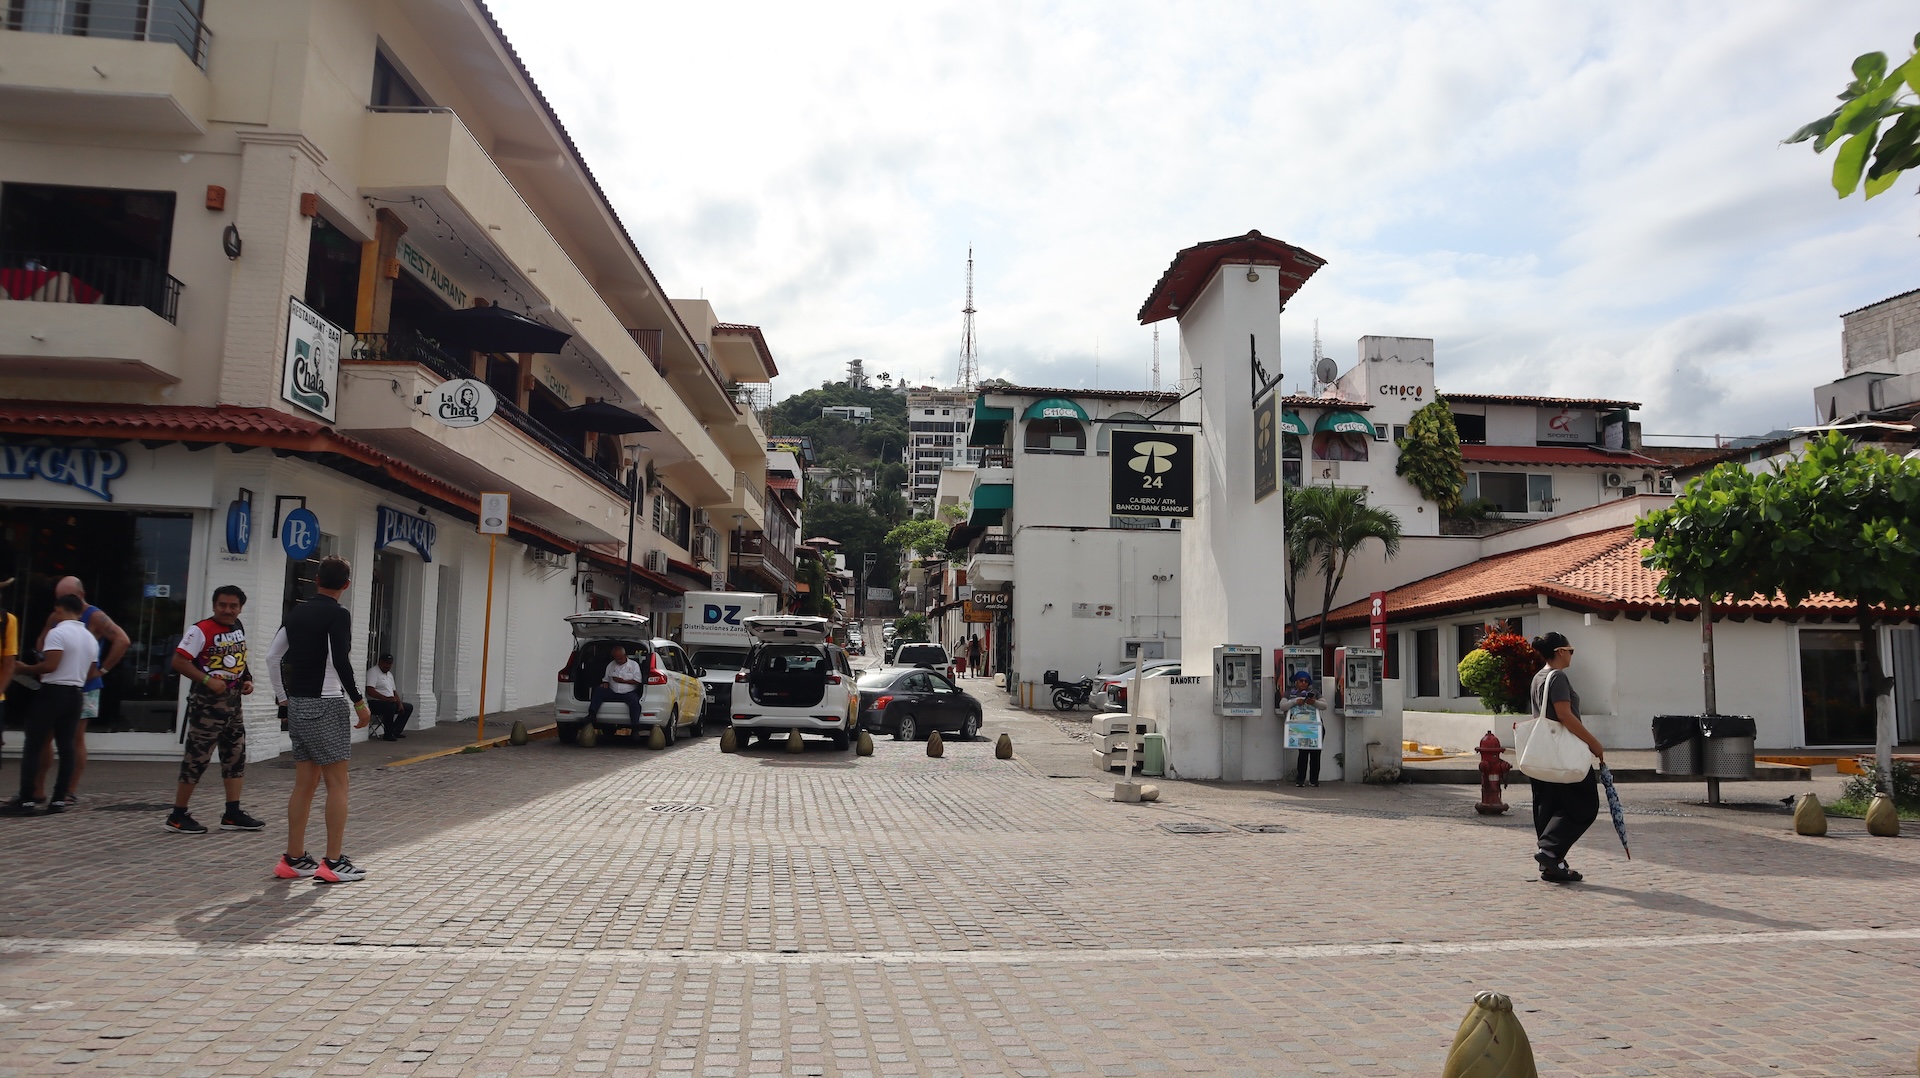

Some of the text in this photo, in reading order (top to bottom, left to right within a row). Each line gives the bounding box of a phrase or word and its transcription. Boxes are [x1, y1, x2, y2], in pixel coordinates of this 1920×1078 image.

[403, 242, 467, 308] RESTAURANT
[291, 303, 326, 334] RESTAURANT
[328, 328, 340, 344] BAR
[293, 357, 330, 408] Chata
[441, 393, 453, 403] La
[438, 403, 479, 422] Chata
[40, 448, 122, 497] CAP
[1143, 475, 1163, 489] 24
[1116, 503, 1140, 511] BANCO
[1129, 496, 1156, 504] CAJERO
[289, 519, 311, 550] PC
[704, 604, 741, 625] DZ
[684, 624, 729, 632] Distribuciones
[1170, 676, 1201, 685] BANORTE
